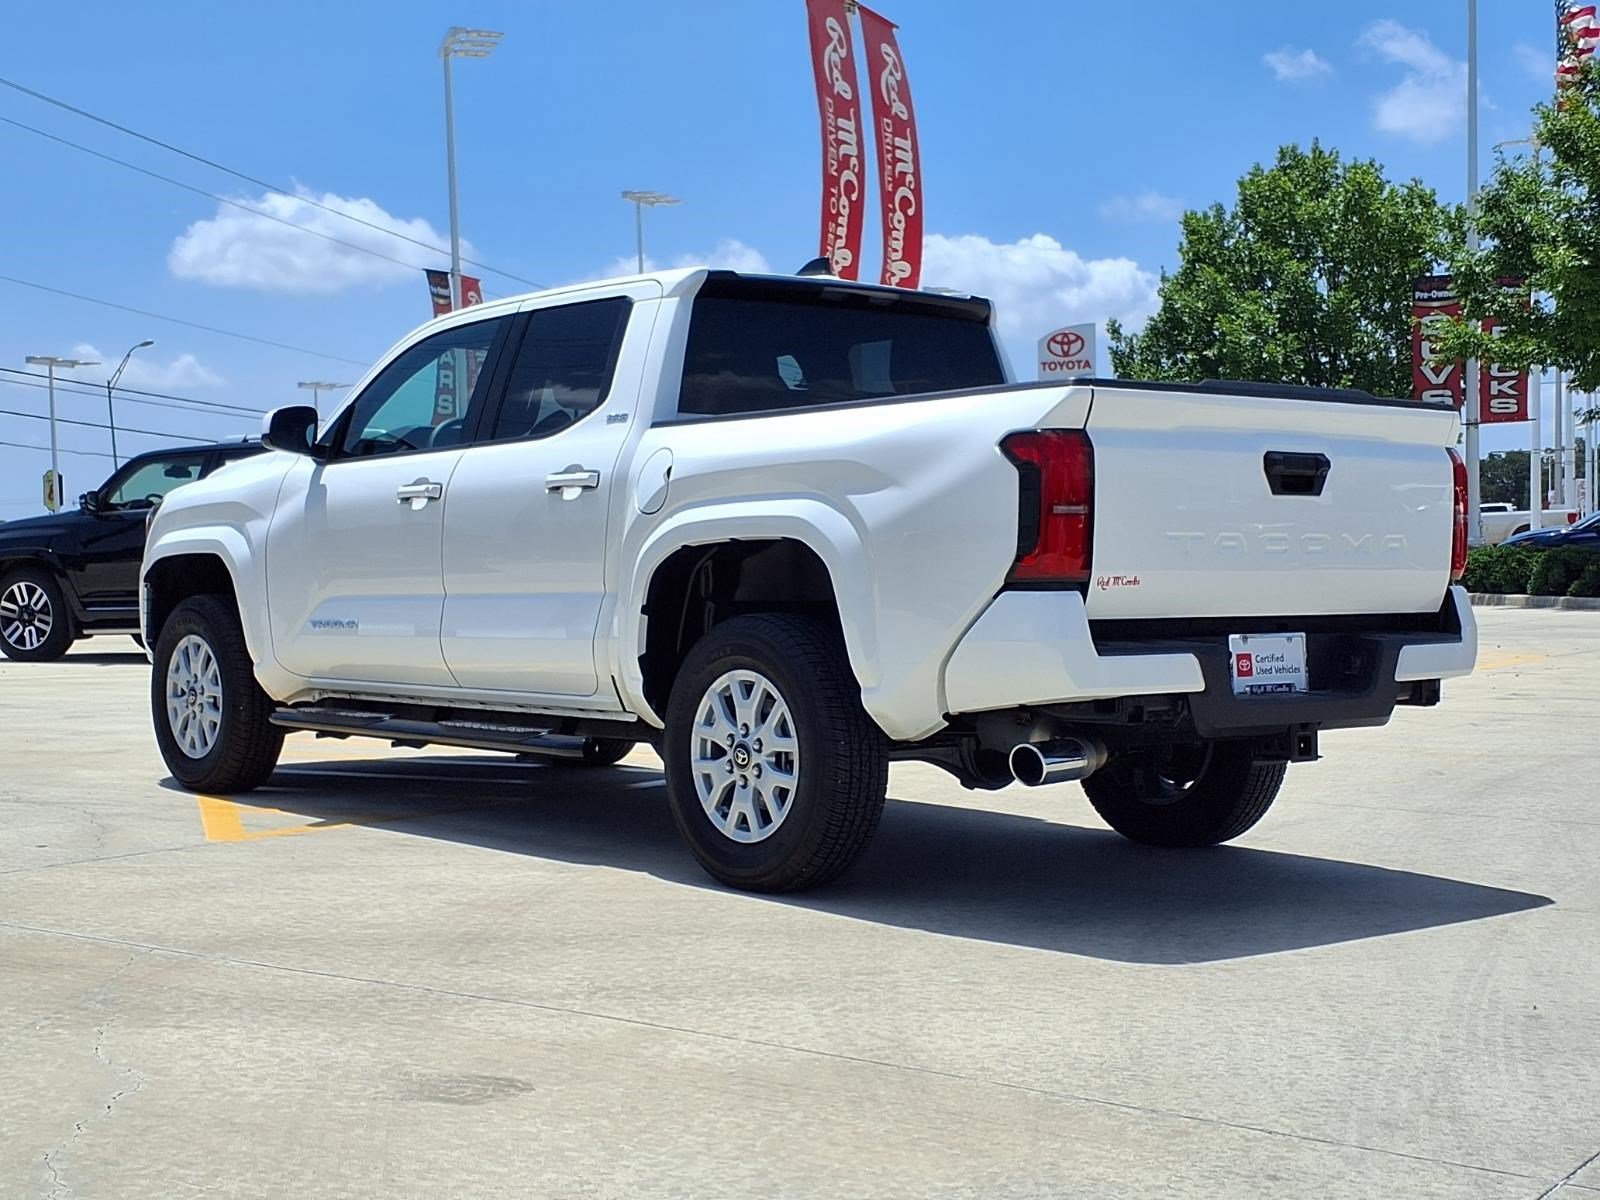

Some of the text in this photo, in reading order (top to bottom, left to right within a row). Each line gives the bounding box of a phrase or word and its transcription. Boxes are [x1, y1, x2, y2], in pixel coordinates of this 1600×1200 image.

[825, 16, 852, 101] Red
[881, 42, 909, 121] Red
[824, 97, 839, 177] DRIVEN
[829, 185, 838, 215] TO
[1040, 360, 1092, 372] TOYOTA
[1165, 532, 1408, 555] TACOMA
[1096, 575, 1111, 590] Red
[1255, 653, 1285, 664] Certified
[1256, 664, 1301, 675] Used Vehicles
